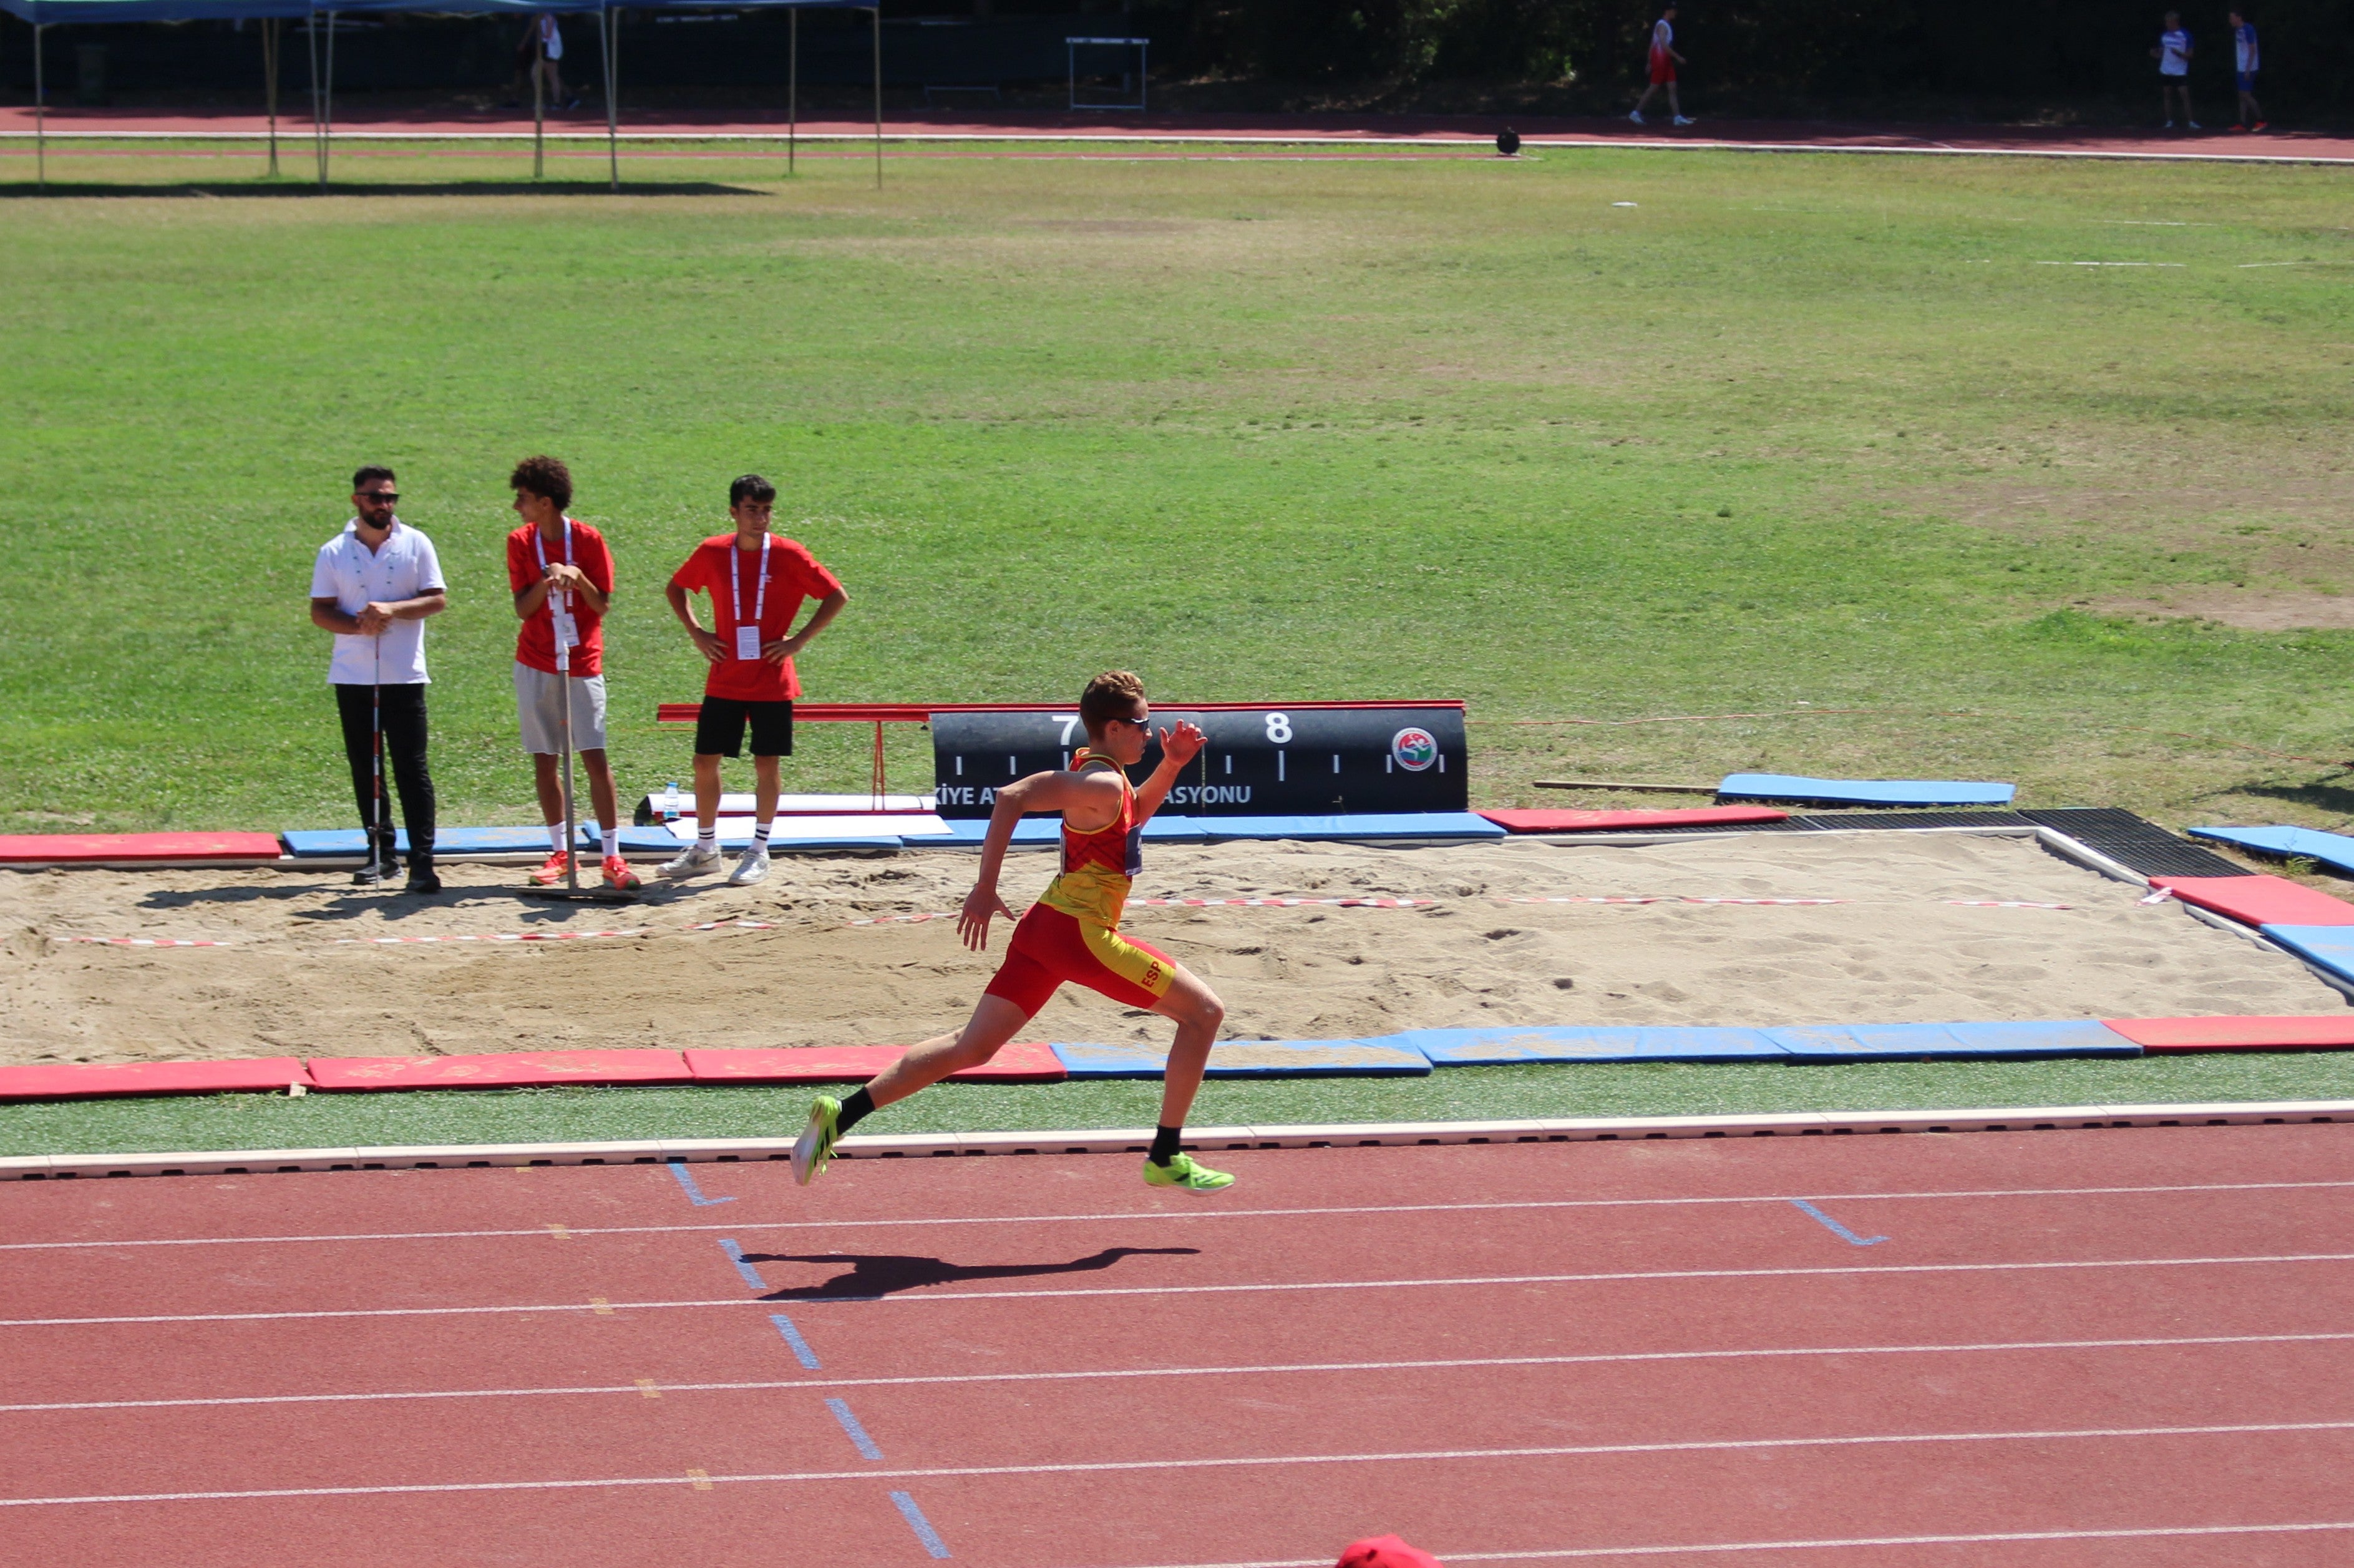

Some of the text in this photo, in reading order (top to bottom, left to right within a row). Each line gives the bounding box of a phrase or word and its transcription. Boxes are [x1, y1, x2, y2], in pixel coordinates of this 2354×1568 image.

[1052, 716, 1079, 746] 7
[1265, 712, 1293, 743] 8
[1141, 961, 1161, 988] ESP
